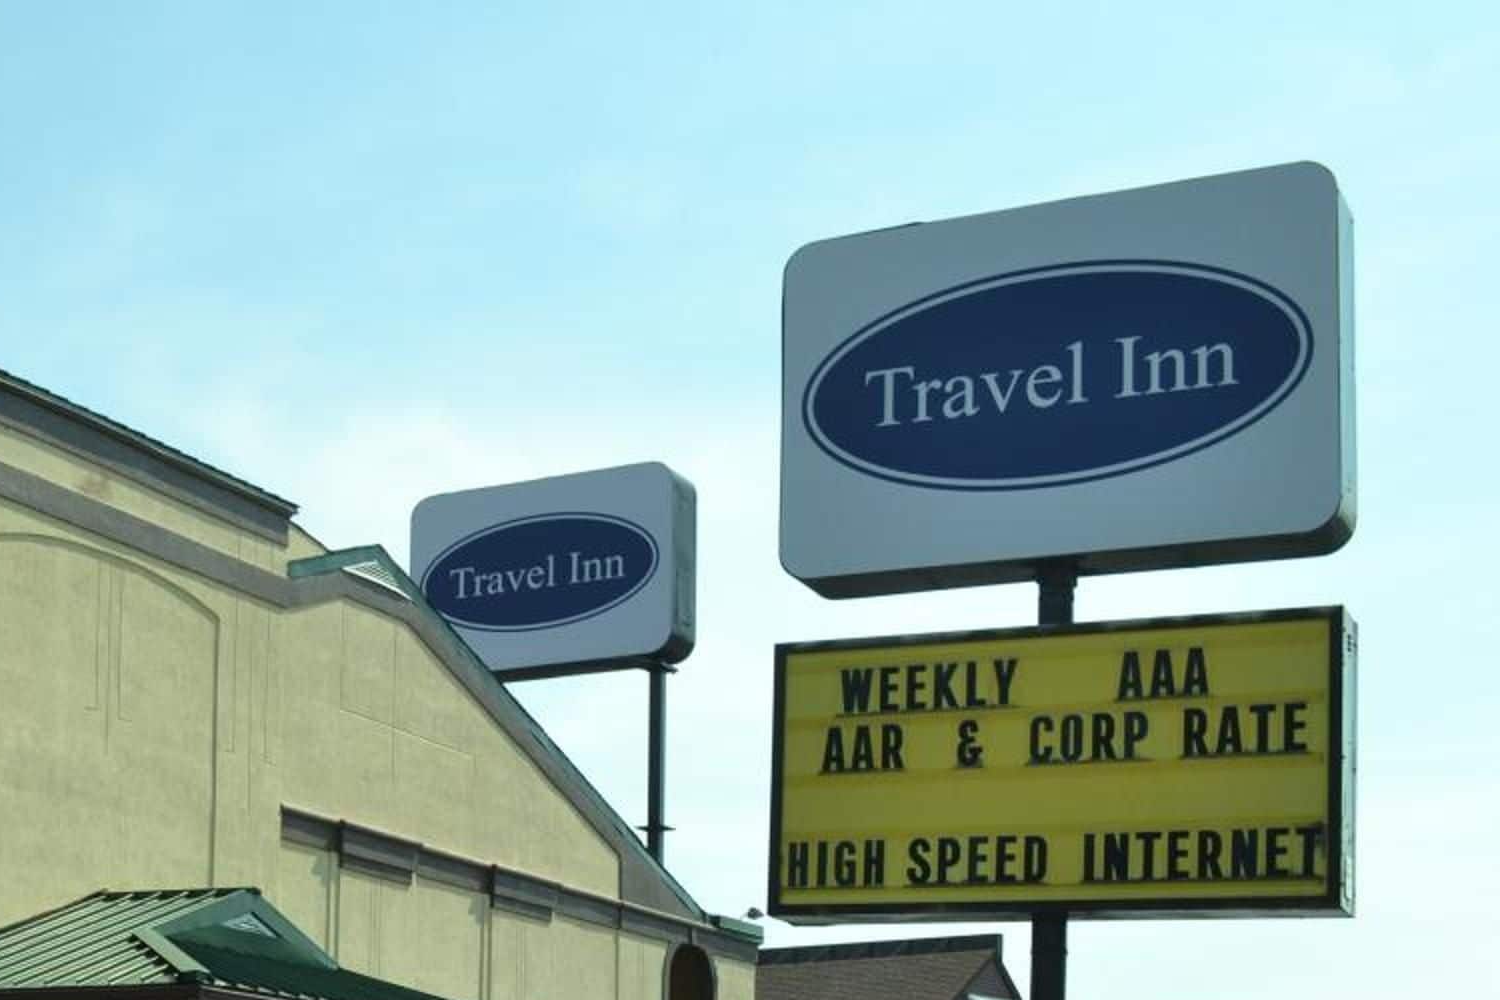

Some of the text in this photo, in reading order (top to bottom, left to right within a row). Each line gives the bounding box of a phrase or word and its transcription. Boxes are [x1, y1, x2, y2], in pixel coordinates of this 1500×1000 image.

[865, 335, 1239, 427] Travel Inn
[450, 552, 625, 599] Travel Inn
[840, 648, 1209, 713] WEEKLY AAA
[823, 703, 1308, 772] AAR & CORP RATE
[789, 826, 1324, 888] HIGH SPEED INTERNET
